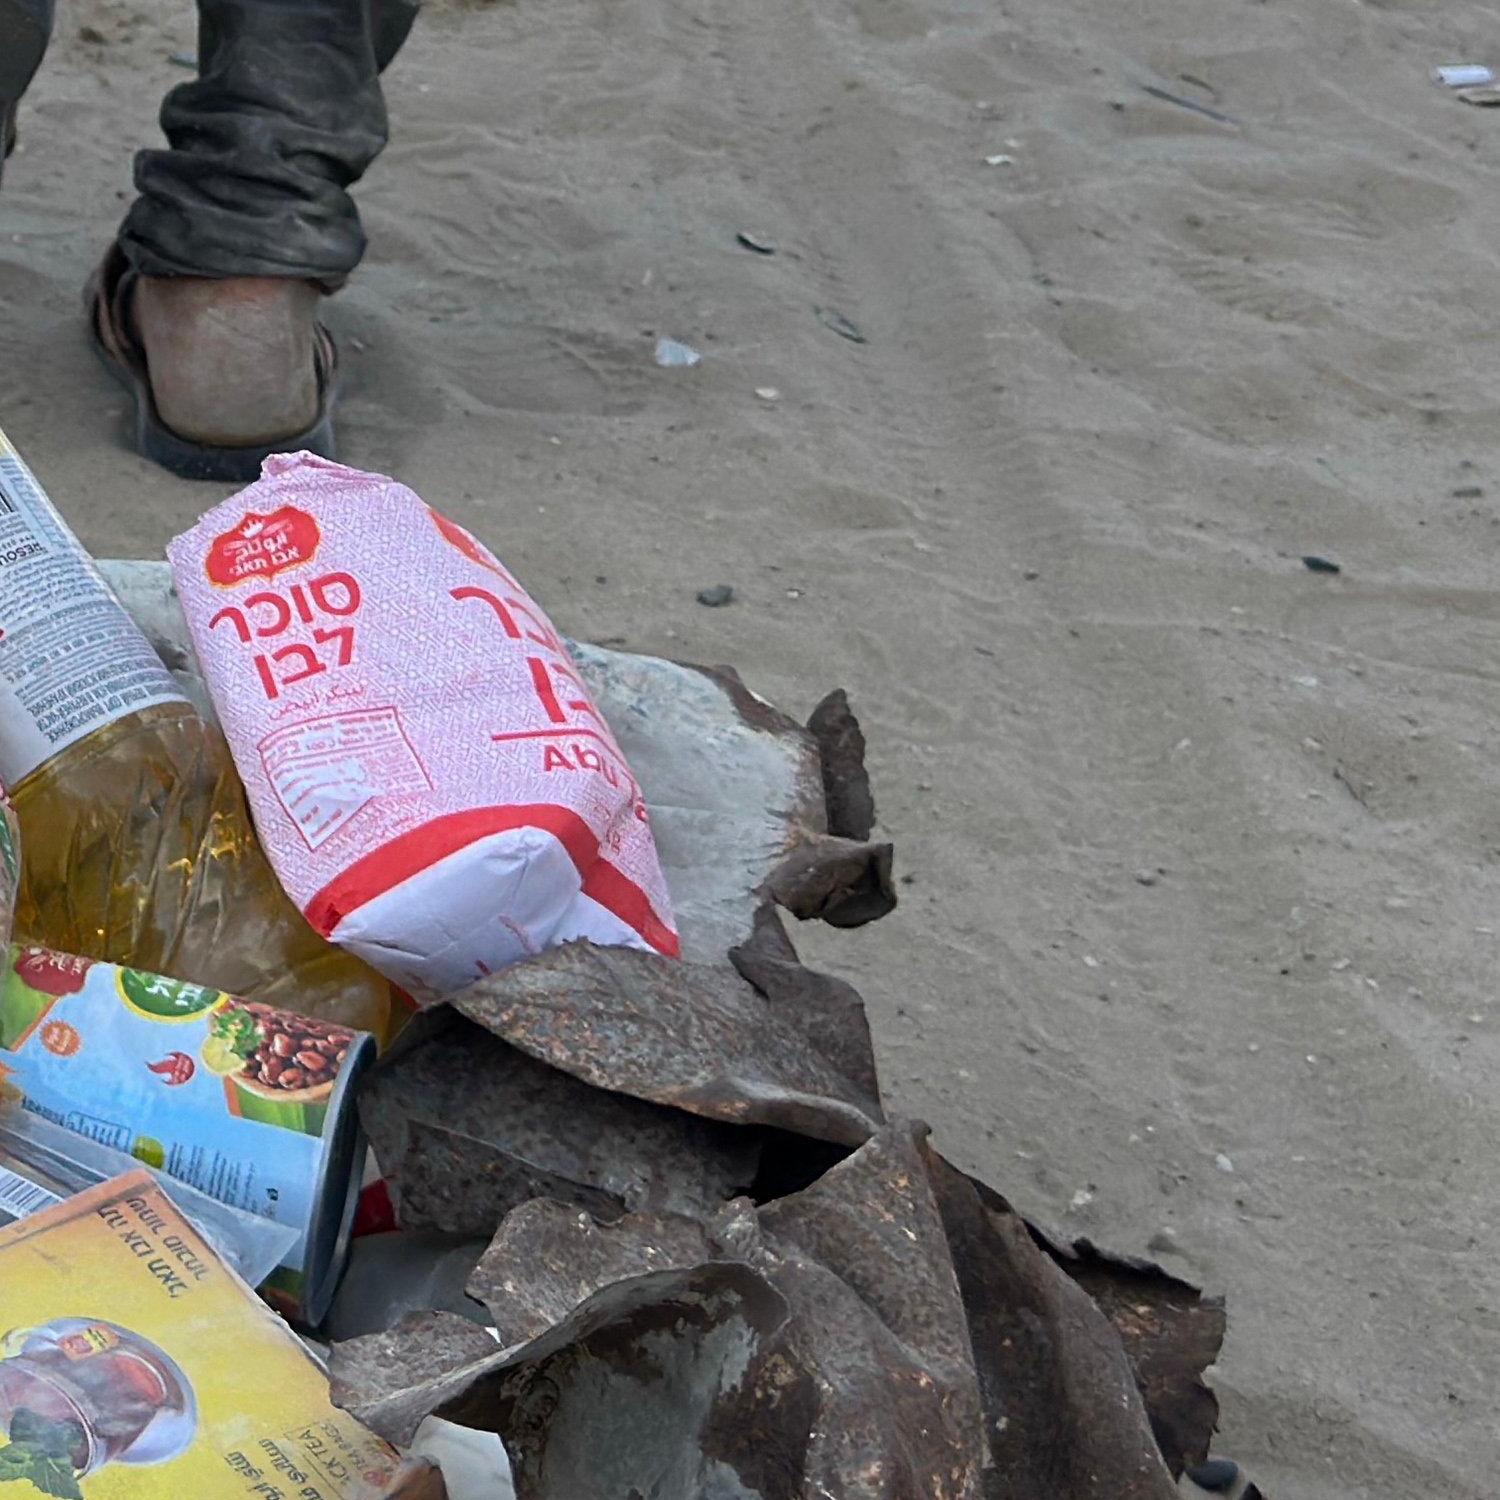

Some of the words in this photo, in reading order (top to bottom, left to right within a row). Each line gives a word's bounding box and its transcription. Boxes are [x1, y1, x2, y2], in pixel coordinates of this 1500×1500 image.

[209, 571, 361, 642] סוכר
[252, 626, 355, 700] לבן
[543, 744, 618, 788] Abu
[97, 1203, 127, 1229] תה
[120, 1229, 154, 1258] אבו
[125, 1195, 164, 1235] שחור
[298, 1429, 328, 1455] TEA
